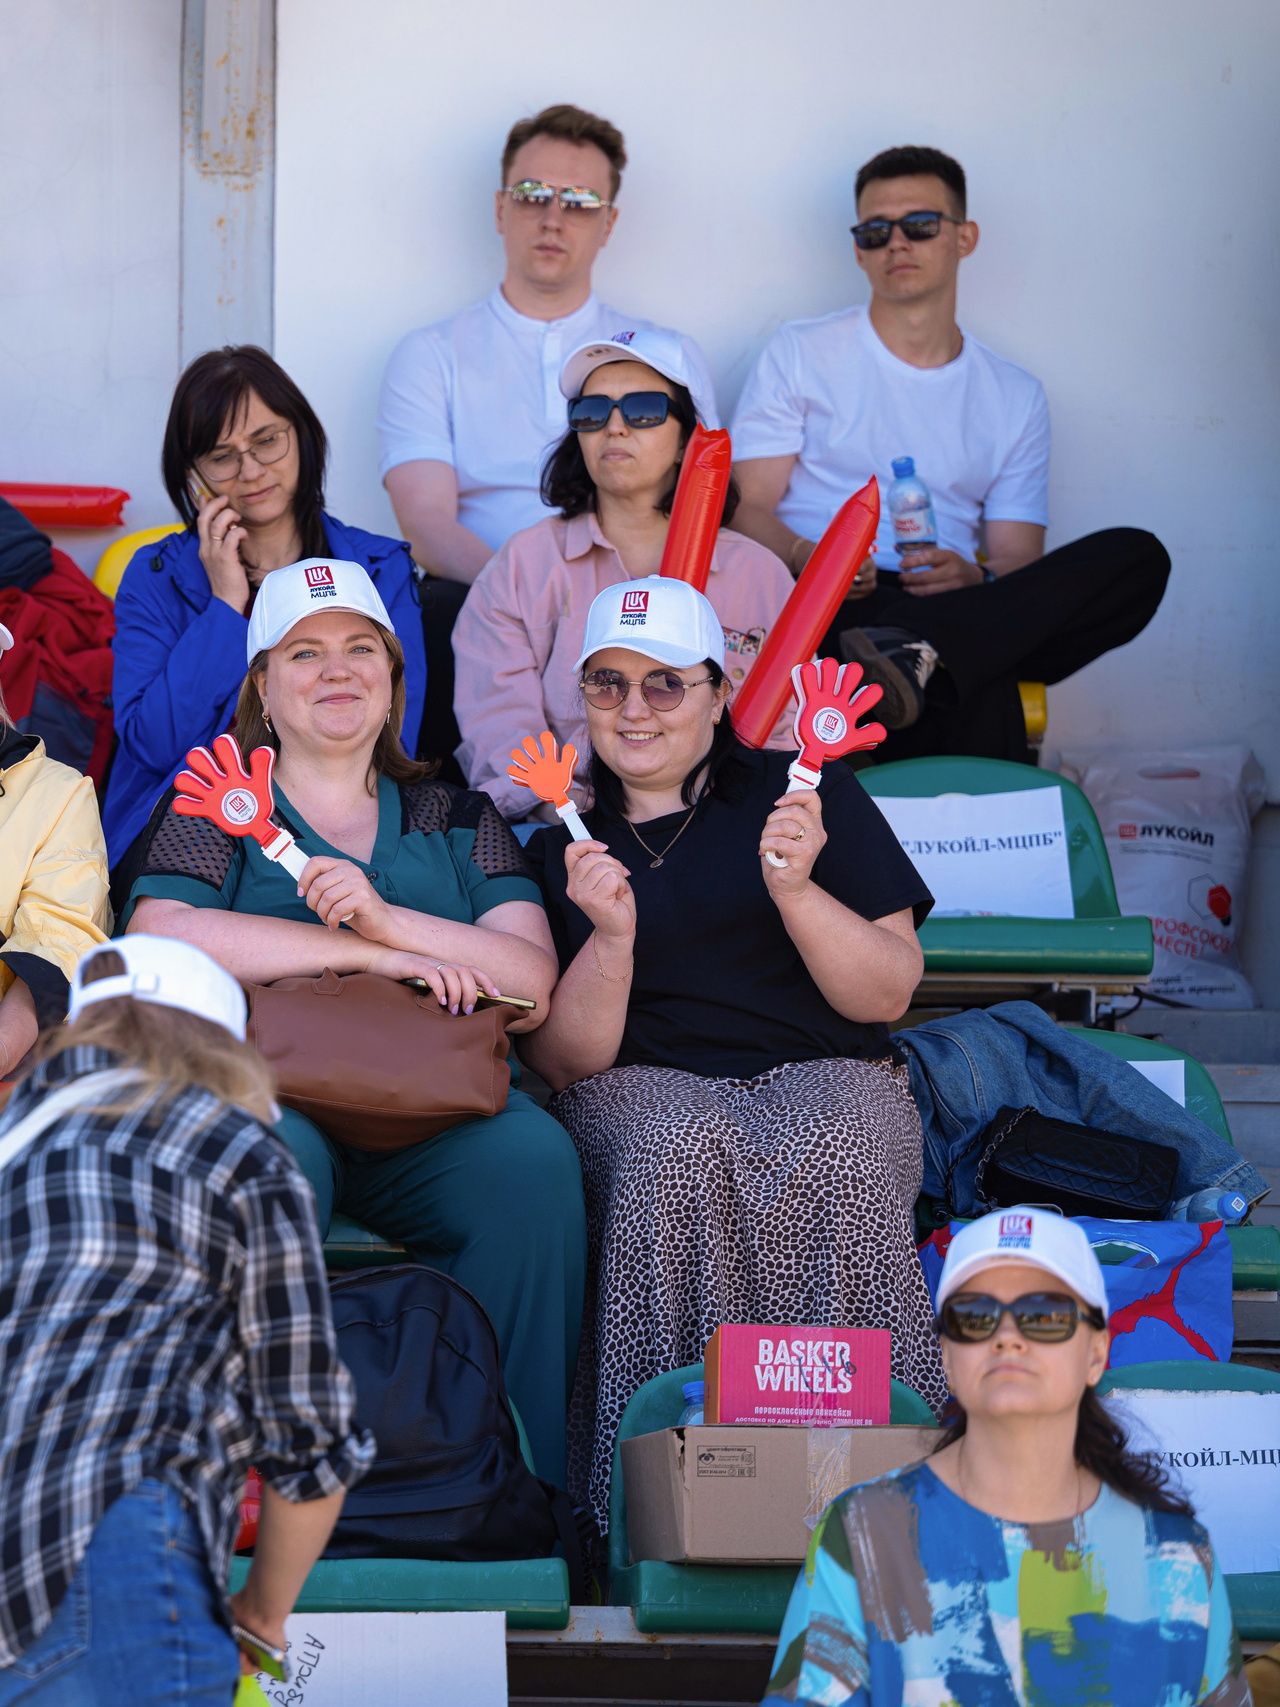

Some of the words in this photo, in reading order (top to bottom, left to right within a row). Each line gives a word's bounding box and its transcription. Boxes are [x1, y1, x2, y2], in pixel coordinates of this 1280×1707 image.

[305, 566, 332, 585] LUK
[624, 592, 647, 611] LUK
[620, 618, 646, 626] МЦПБ
[901, 831, 1063, 855] "ЛУКОЙЛ-МЦПБ"
[1141, 824, 1215, 847] ЛУКОЙЛ
[1002, 1217, 1031, 1234] LUK
[758, 1339, 850, 1367] BASKER
[754, 1365, 852, 1393] WHEELS
[1127, 1447, 1280, 1467] ЛУКОЙЛ-МЦ
